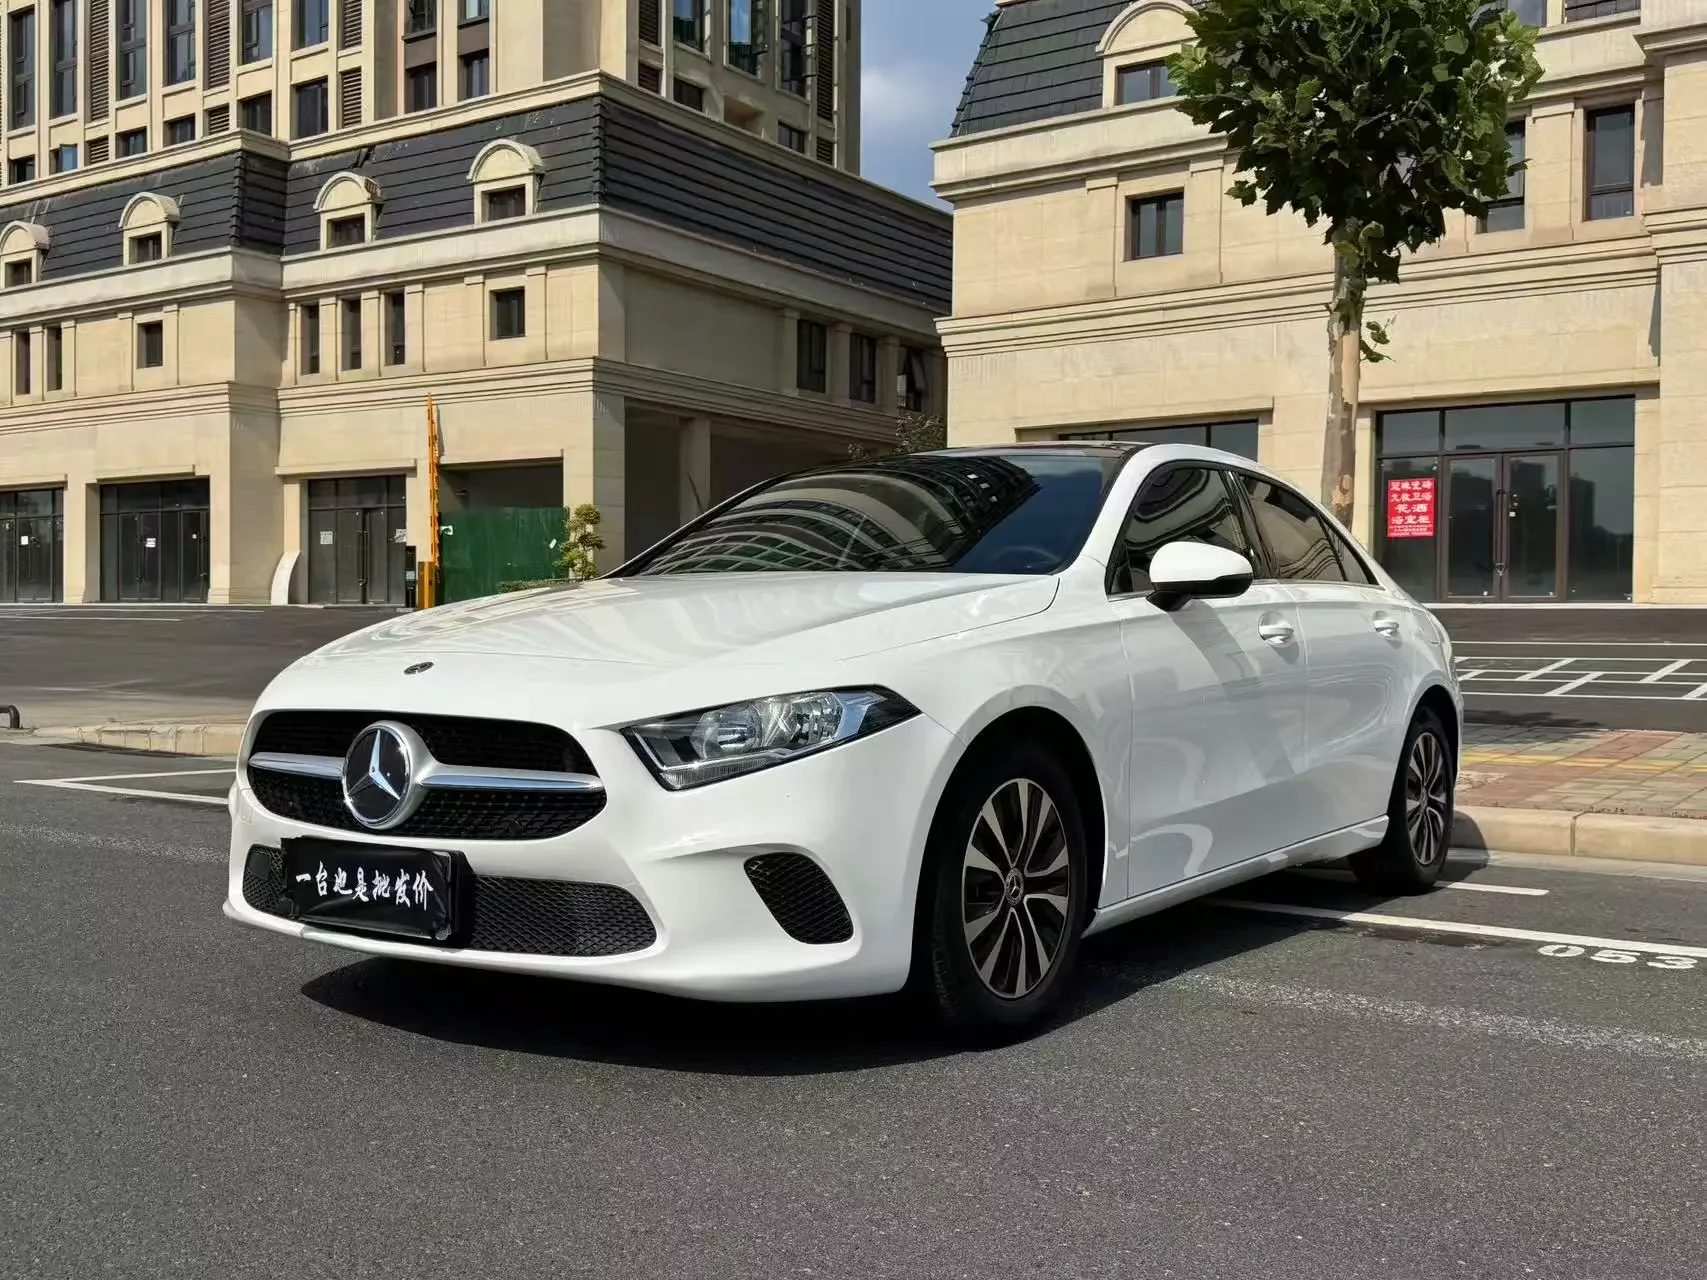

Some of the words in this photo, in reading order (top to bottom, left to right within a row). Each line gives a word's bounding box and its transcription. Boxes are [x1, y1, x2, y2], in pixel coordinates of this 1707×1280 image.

[296, 861, 434, 911] 一台也是批发价
[1537, 944, 1699, 970] 053
